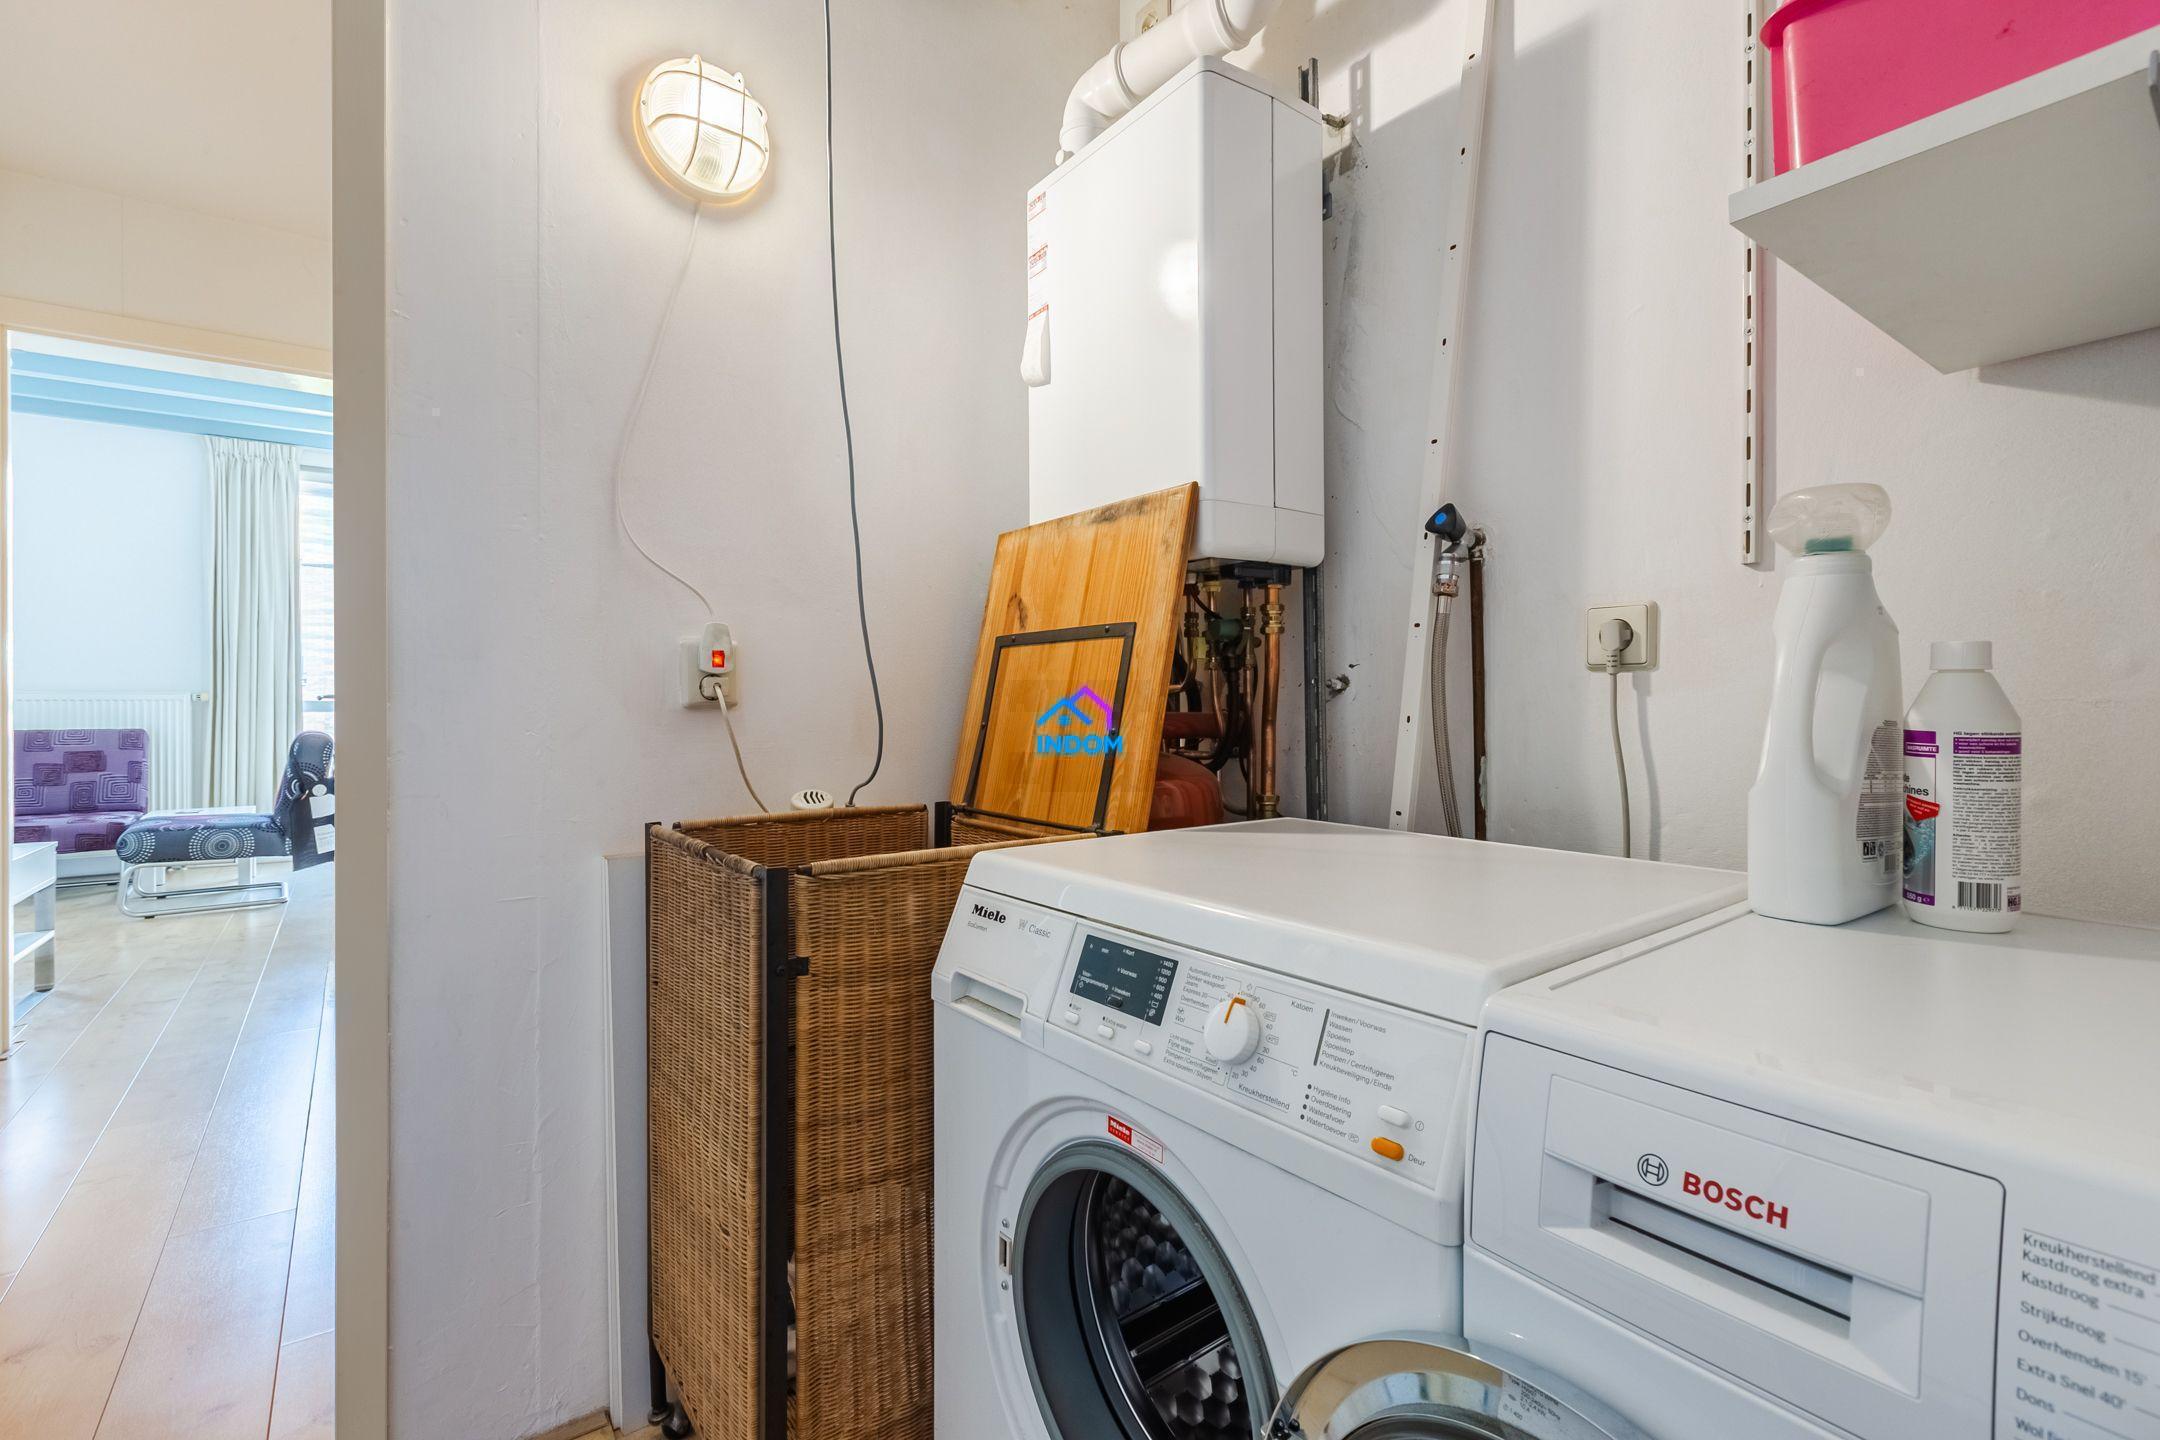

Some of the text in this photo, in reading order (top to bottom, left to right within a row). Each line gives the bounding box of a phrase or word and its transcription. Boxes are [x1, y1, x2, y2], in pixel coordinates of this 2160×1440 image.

[972, 904, 1006, 924] Miele
[1028, 924, 1051, 938] Classic
[1186, 973, 1203, 983] Donker
[1290, 1000, 1313, 1013] Katoen
[1175, 1014, 1185, 1023] Wol
[1328, 1020, 1353, 1034] Wassen
[1326, 1030, 1351, 1043] Spoelen
[1238, 1083, 1290, 1110] Kreukherstellend
[1310, 1095, 1352, 1118] Overdosering
[1338, 1094, 1351, 1105] info
[1306, 1116, 1347, 1138] Watertoevoer
[1308, 1106, 1345, 1126] Waterafvoer
[1408, 1154, 1426, 1166] Deur
[1682, 1171, 1789, 1229] BOSCH
[2024, 1232, 2156, 1286] Kreukherstellend
[2022, 1249, 2146, 1299] Kastdroog extra
[2022, 1270, 2100, 1309] Kastdroog
[2020, 1300, 2106, 1344] Strijkdroog
[2018, 1328, 2120, 1377] Overhemden
[2017, 1357, 2056, 1384] Extra
[2060, 1374, 2096, 1398] Snel
[2016, 1386, 2055, 1414] Dons
[2014, 1416, 2044, 1438] Wol
